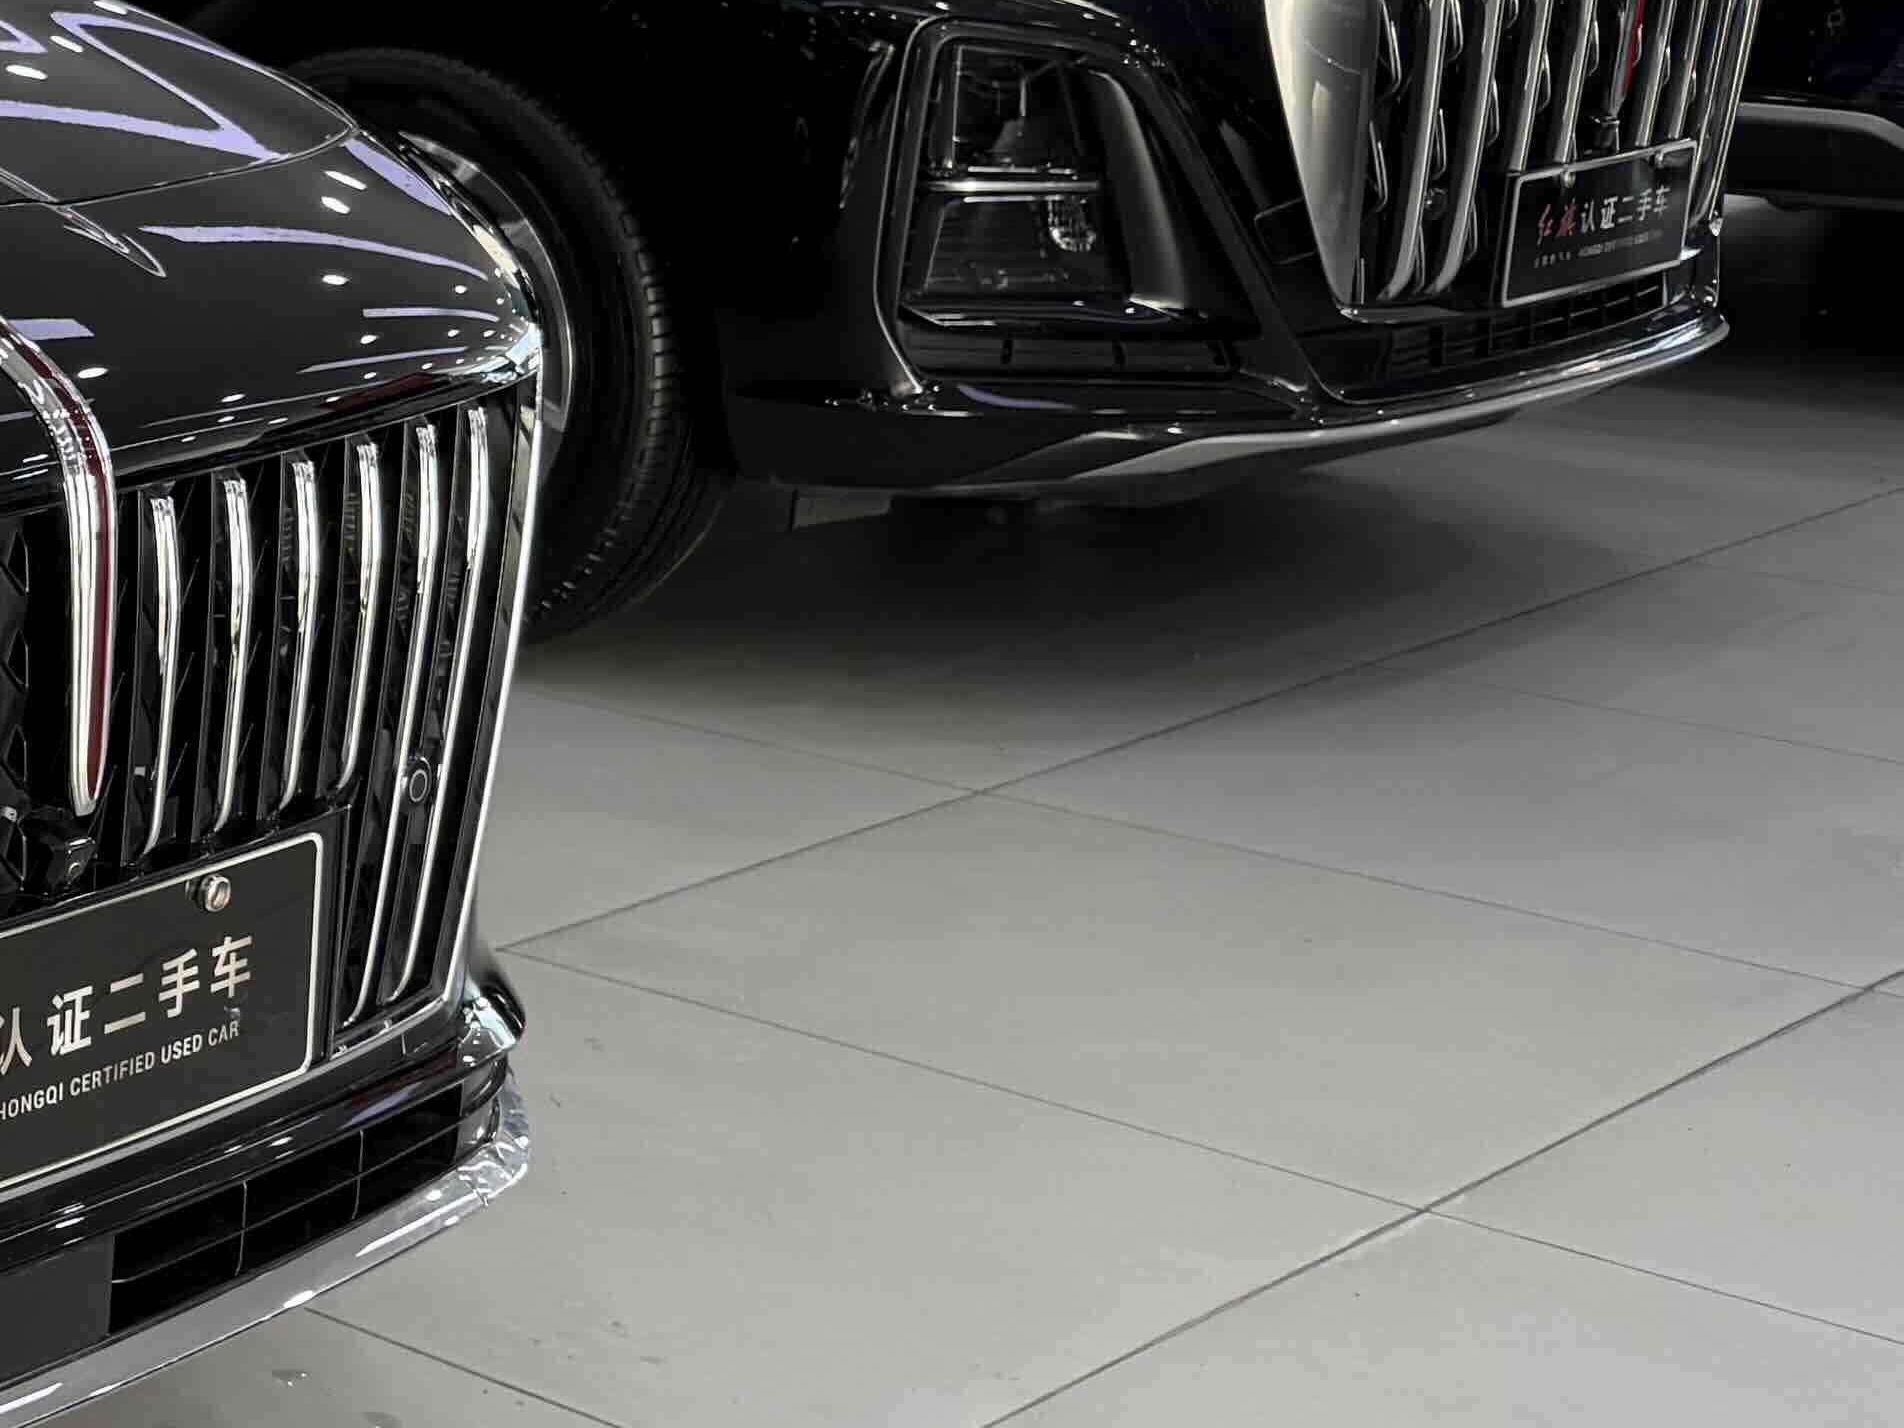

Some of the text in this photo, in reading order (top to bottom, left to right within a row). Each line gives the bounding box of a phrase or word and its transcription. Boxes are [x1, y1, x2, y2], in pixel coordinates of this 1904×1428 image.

[69, 1050, 156, 1098] CERTIFIED
[160, 1033, 204, 1066] USED
[207, 1020, 241, 1048] CAR
